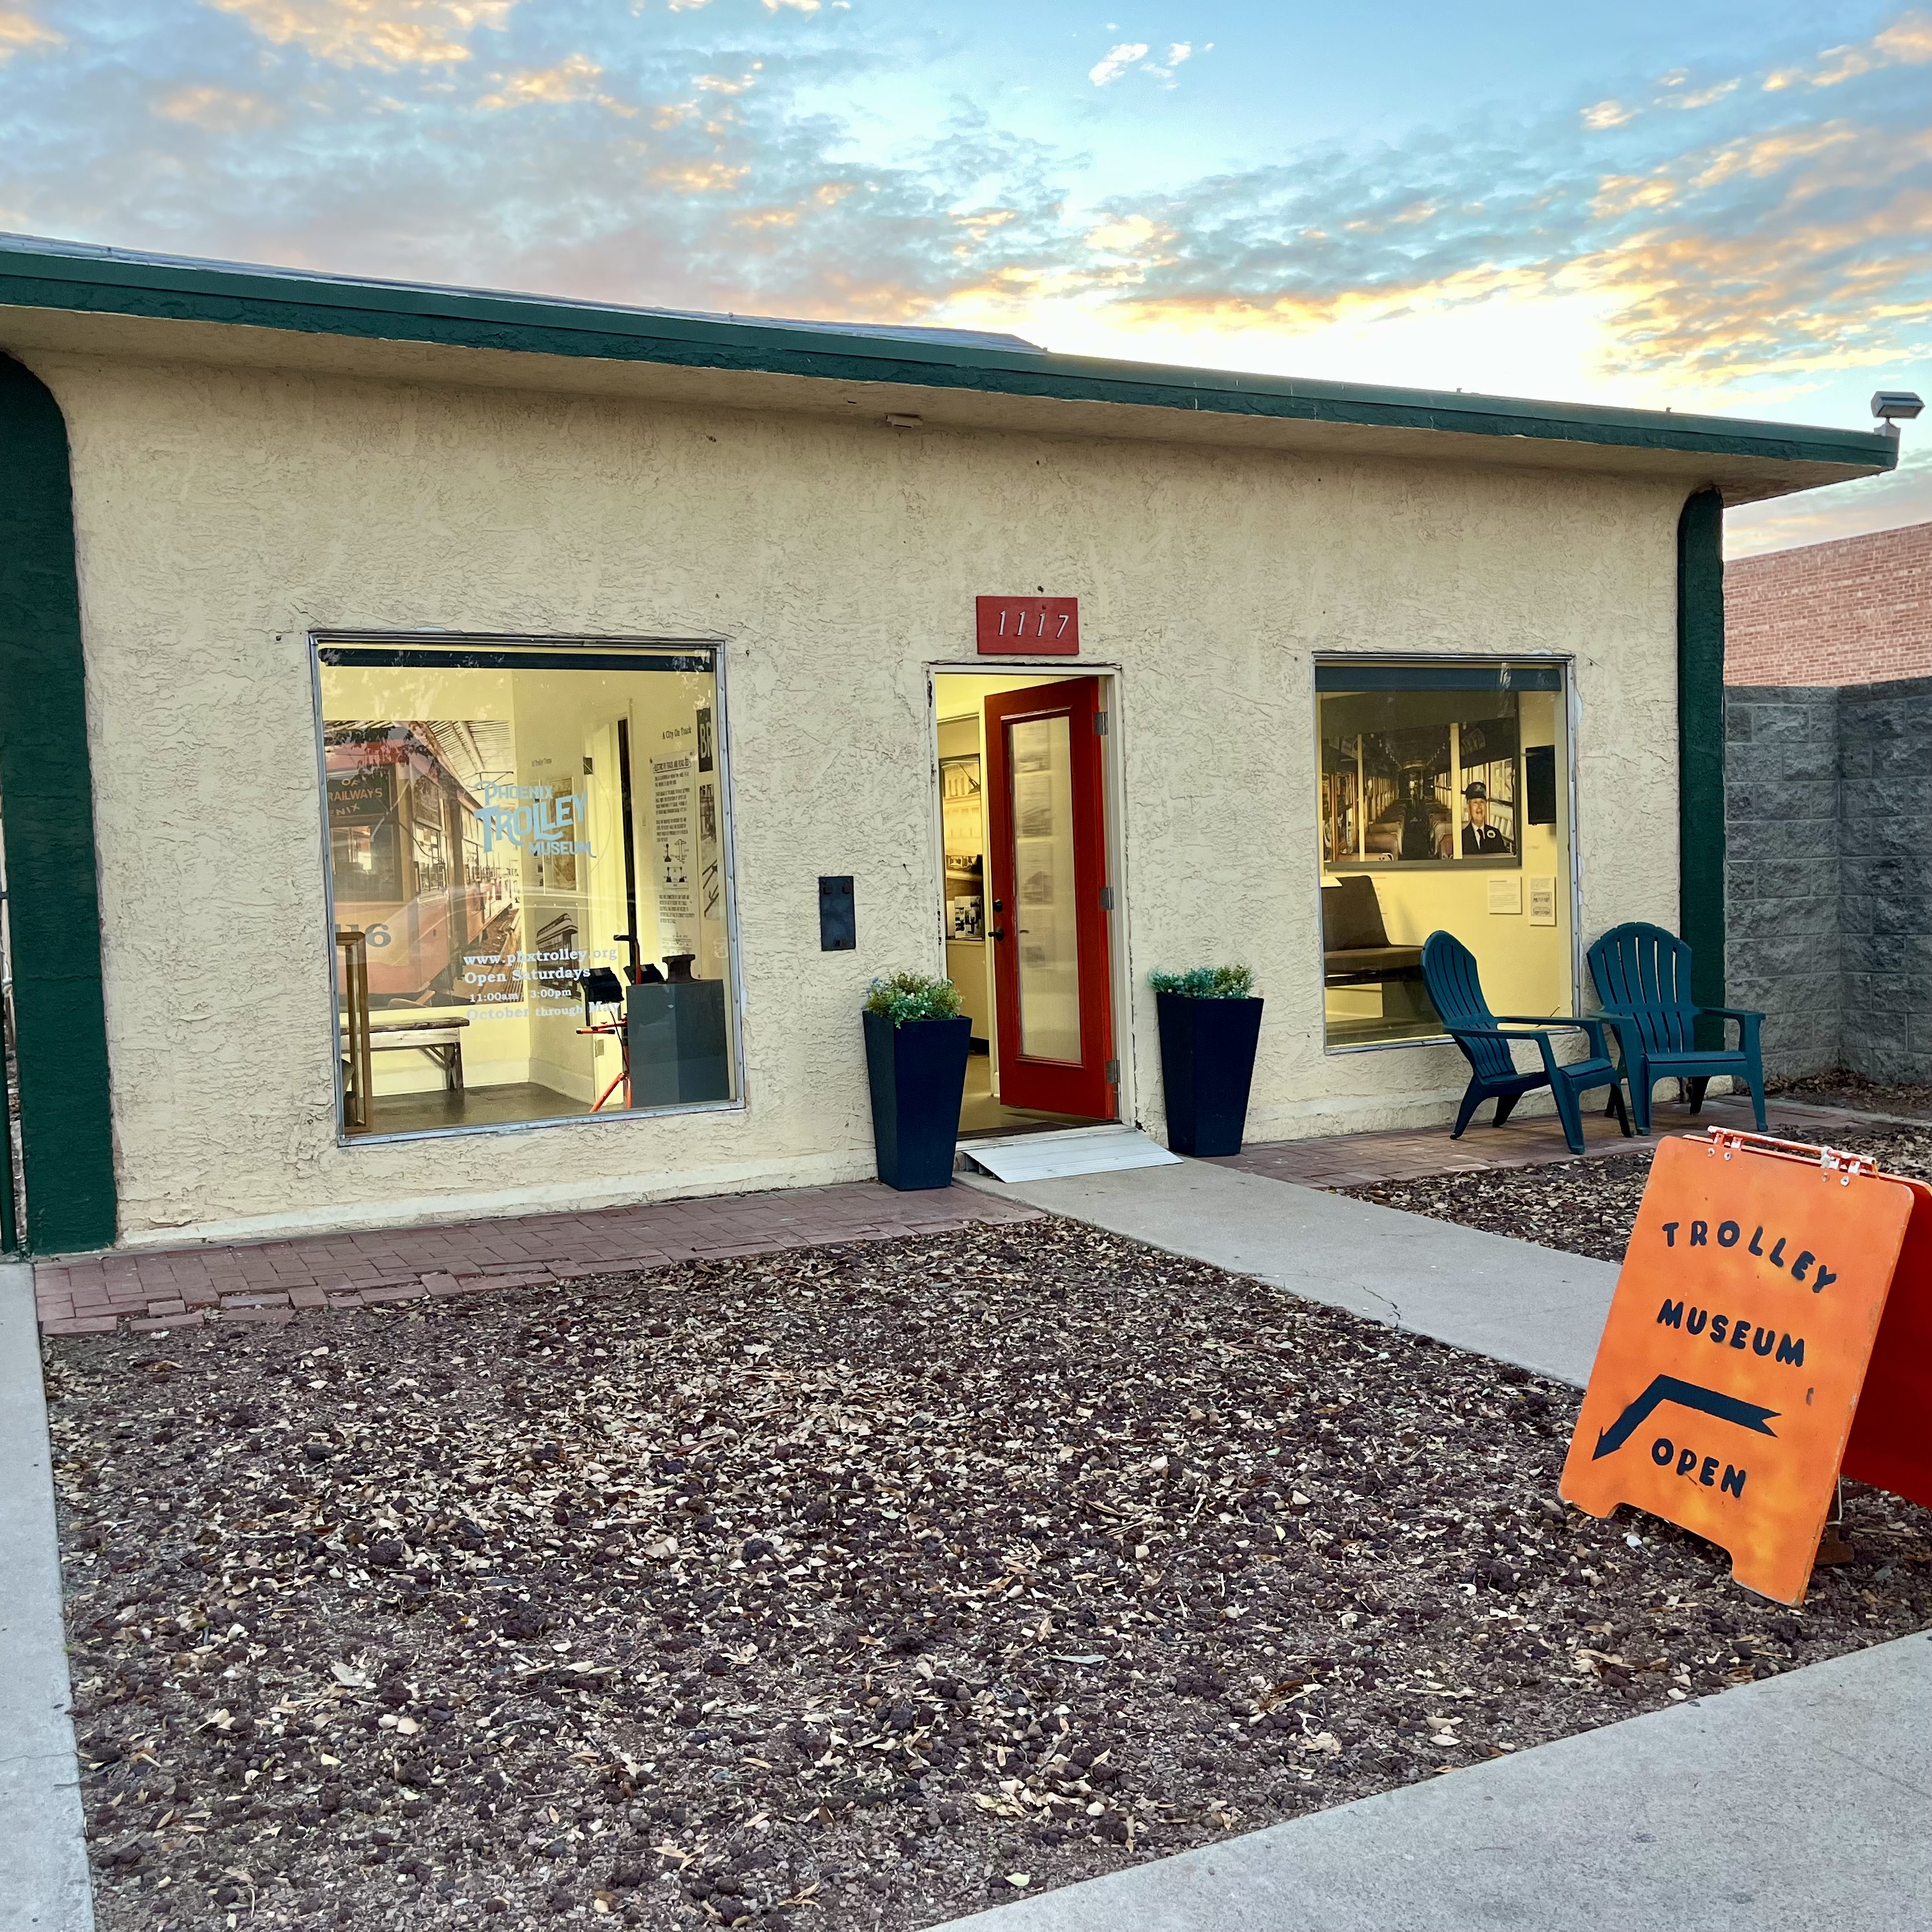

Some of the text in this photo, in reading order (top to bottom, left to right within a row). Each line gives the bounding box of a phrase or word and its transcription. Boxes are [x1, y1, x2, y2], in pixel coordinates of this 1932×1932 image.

[999, 610, 1070, 639] 1117
[328, 787, 383, 802] RAILWAYS
[473, 780, 554, 806] PHOENIX
[473, 792, 588, 854] TROLLEY
[528, 841, 597, 859] MUSEUM
[463, 948, 618, 967] www.phxtrolley.org
[464, 966, 592, 986] Open Saturdays
[469, 988, 572, 1003] 11:00am 3:00pm
[466, 1000, 620, 1021] October through May
[1662, 1220, 1837, 1294] TROLLEY
[1657, 1298, 1805, 1367] MUSEUM
[1651, 1438, 1746, 1498] OPEN
